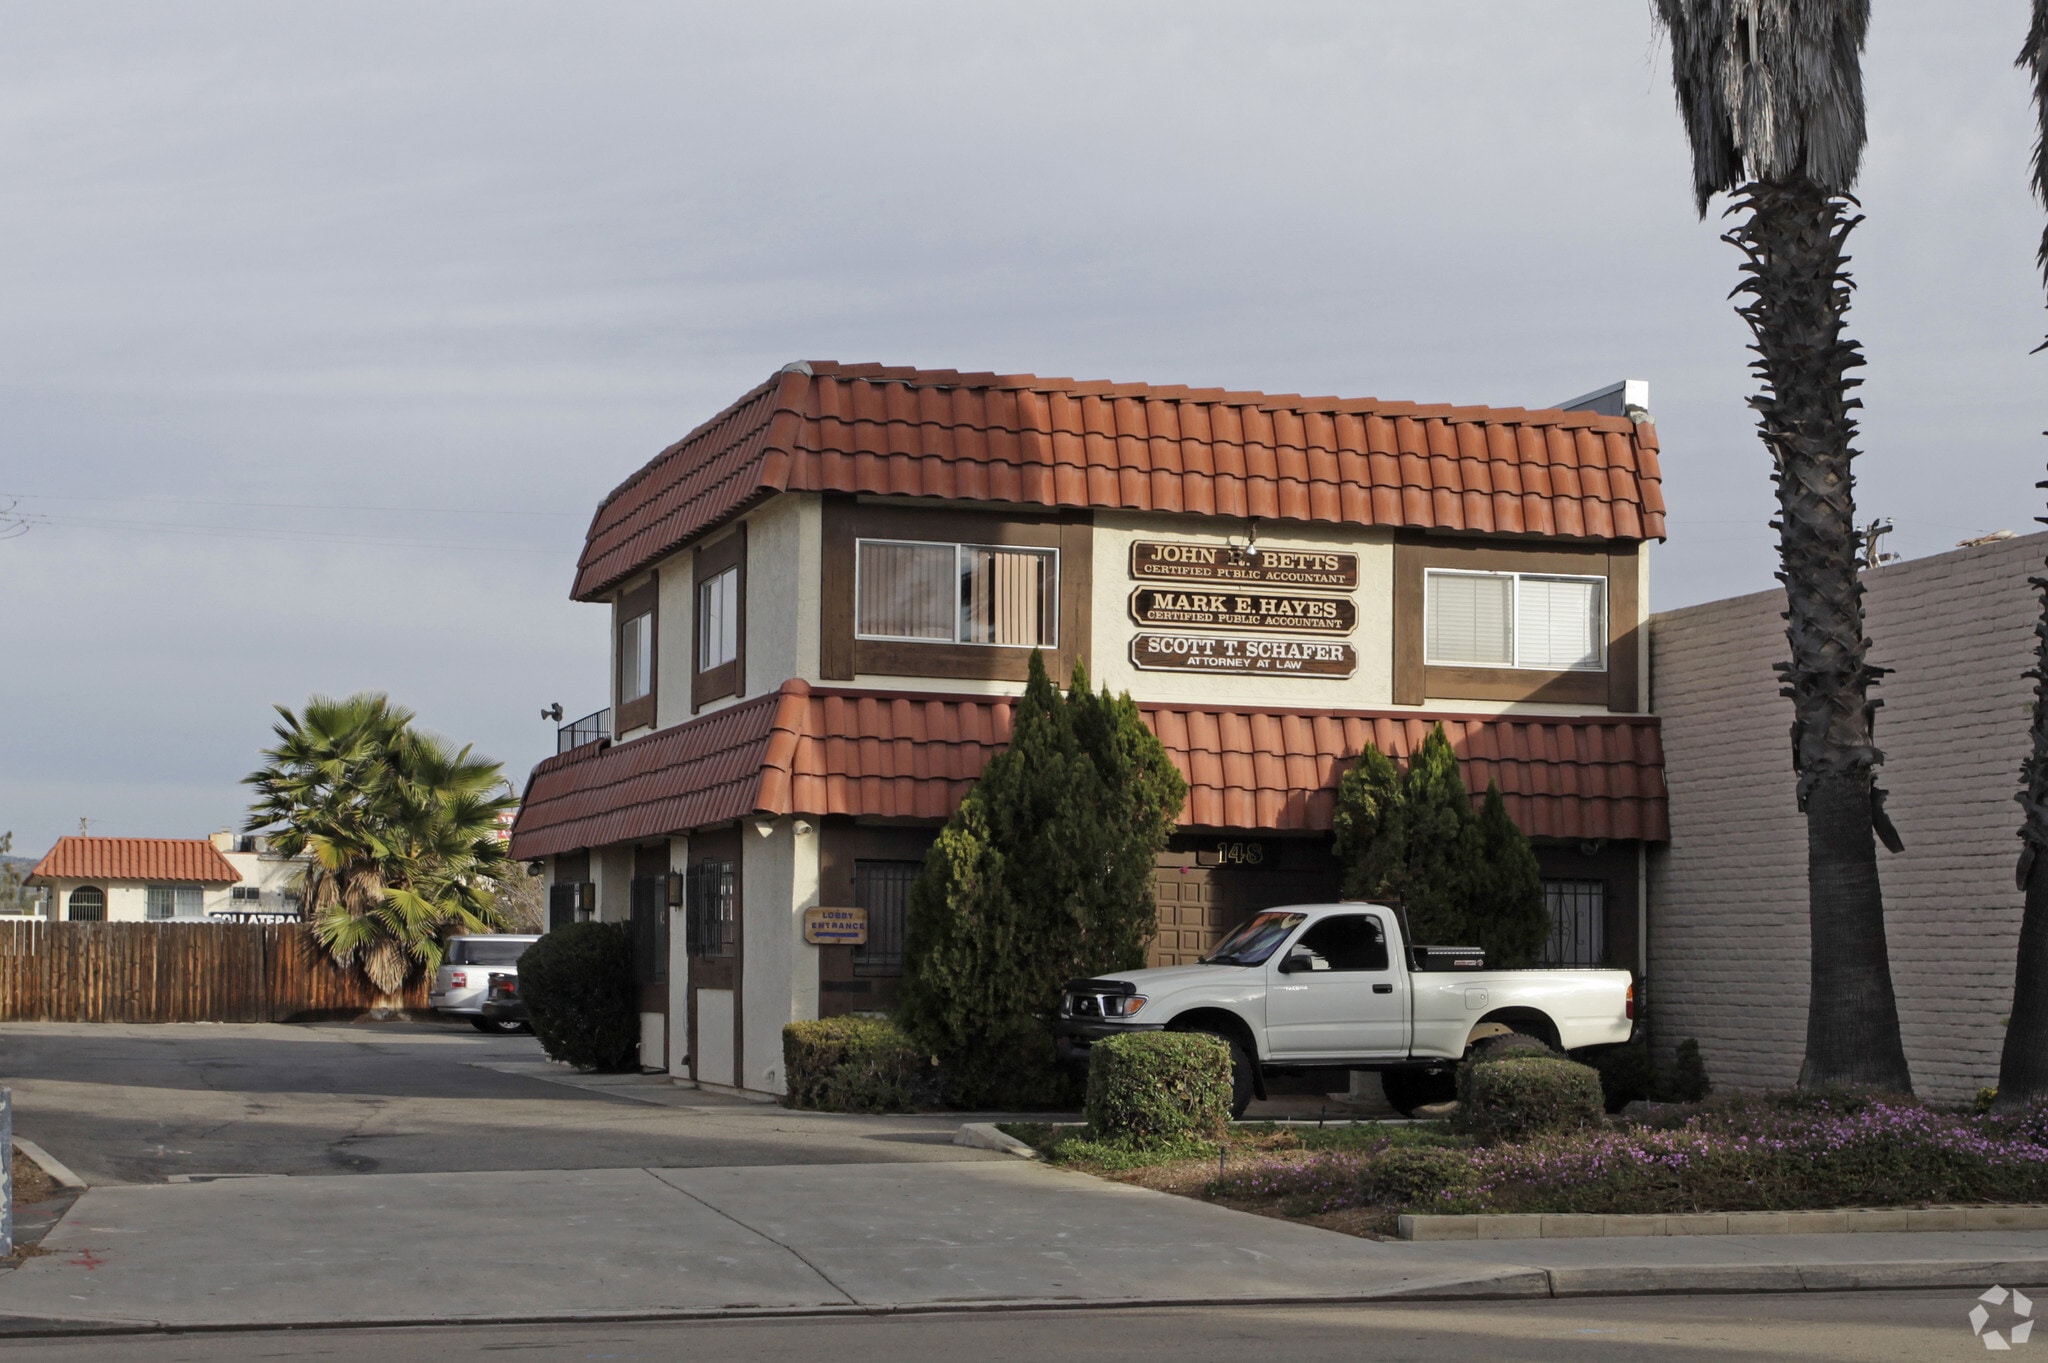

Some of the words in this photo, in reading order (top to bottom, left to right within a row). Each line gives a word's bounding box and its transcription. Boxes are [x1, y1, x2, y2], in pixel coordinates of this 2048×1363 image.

[1150, 545, 1217, 564] JOHN
[1262, 552, 1339, 571] BETTS
[1143, 564, 1212, 576] CERTIFIED
[1217, 568, 1261, 580] PUBLIC
[1266, 572, 1346, 584] ACCOUNTANT
[1152, 593, 1227, 613] MARK
[1235, 597, 1256, 614] E.
[1259, 598, 1337, 618] HAYES
[1147, 611, 1213, 622] CERTIFIED
[1218, 614, 1261, 625] PUBLIC
[1265, 617, 1343, 629] ACCOUNTANT
[1148, 636, 1216, 655] SCOTT
[1223, 640, 1241, 656] T.
[1246, 641, 1344, 661] SCHAFER
[1187, 656, 1251, 668] ATTORNEY
[1256, 658, 1272, 668] AT
[1276, 660, 1302, 670] LAW
[1217, 841, 1263, 865] 148
[811, 922, 865, 930] ENTRANCE
